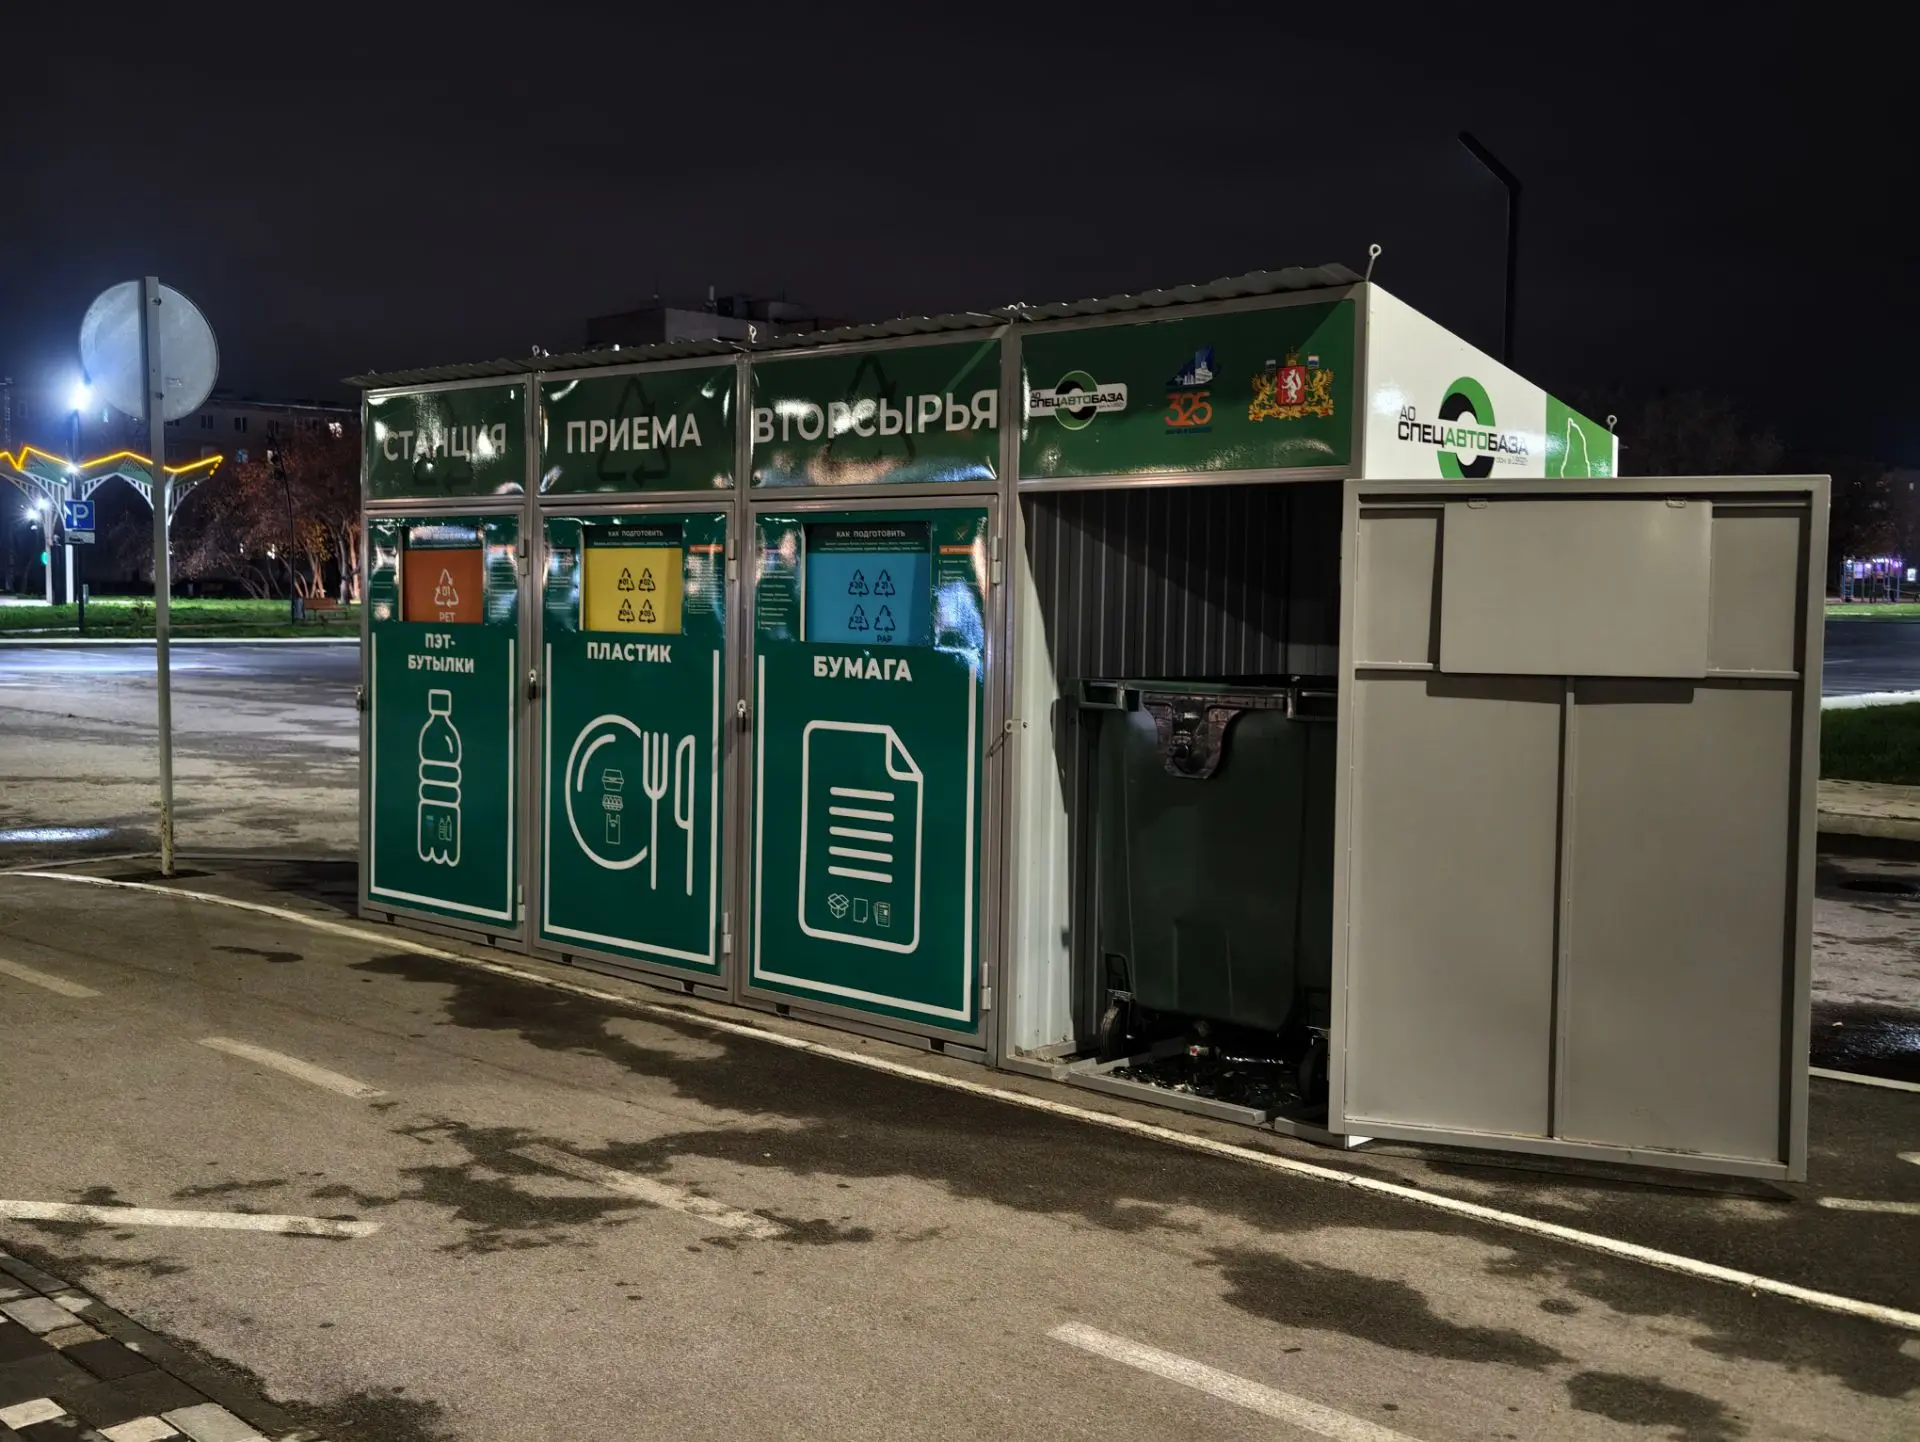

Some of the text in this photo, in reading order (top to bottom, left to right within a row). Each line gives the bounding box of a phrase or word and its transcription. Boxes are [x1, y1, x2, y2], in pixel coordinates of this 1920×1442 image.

[1030, 392, 1125, 409] СПЕЦАВТОБАЗА
[1399, 406, 1416, 422] АО
[383, 389, 998, 462] СТАНЦИЯ ПРИЕМА ВТОРСЫРЬЯ
[1398, 421, 1529, 456] СПЕЦАВТОБАЗА
[73, 504, 89, 527] P
[836, 530, 906, 539] КАК ПОДГОТОВИТЬ
[425, 633, 456, 649] ПЭТ-
[587, 642, 672, 663] ПЛАСТИК
[407, 654, 475, 674] БУТЫЛКИ
[813, 655, 913, 682] БУМАГА
